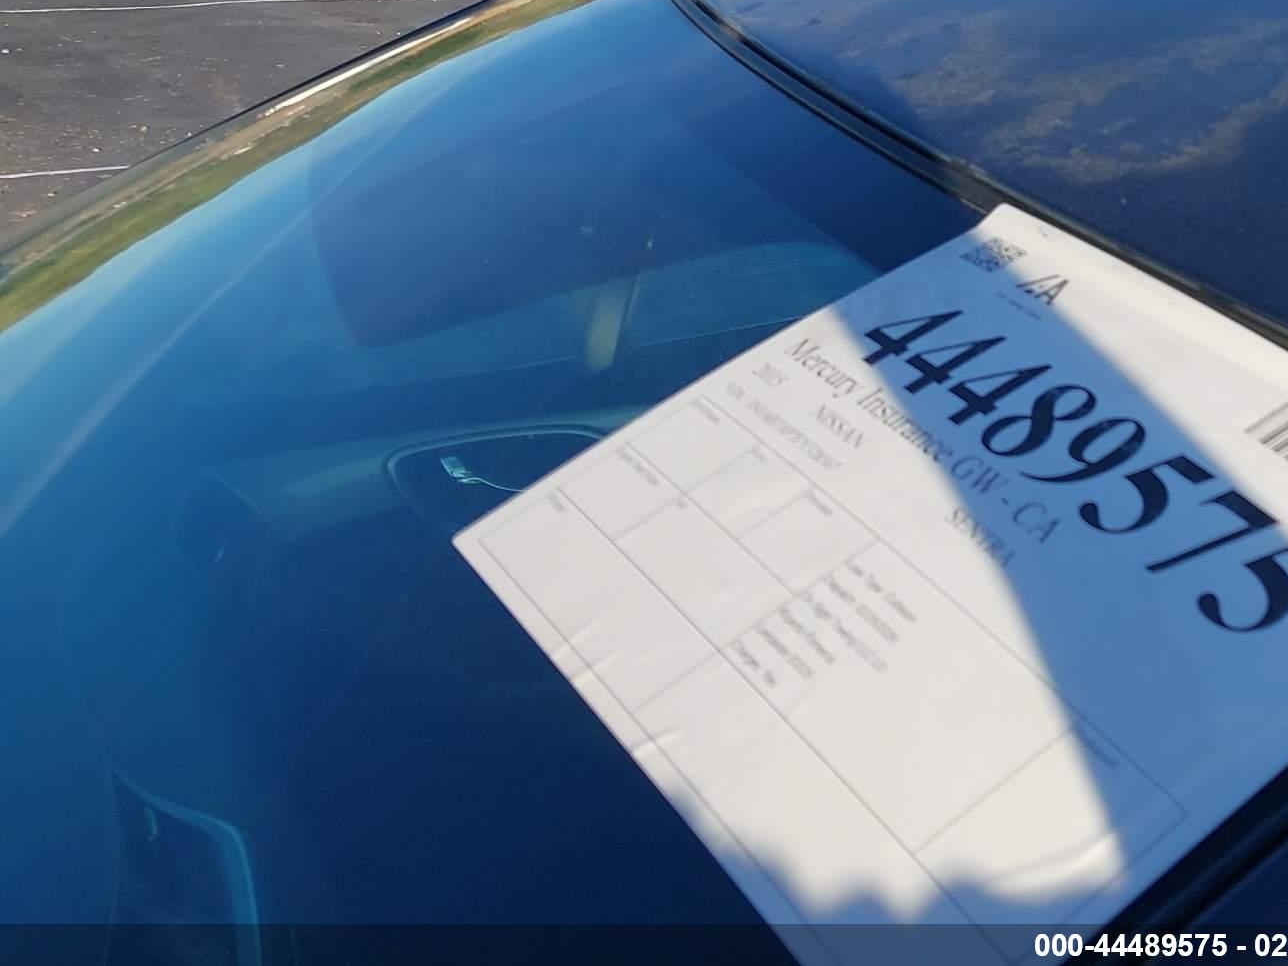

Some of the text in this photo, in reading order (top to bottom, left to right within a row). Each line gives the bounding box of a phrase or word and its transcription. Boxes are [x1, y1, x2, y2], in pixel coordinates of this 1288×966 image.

[783, 338, 859, 398] Mercury
[856, 386, 953, 462] Insurance
[951, 455, 1011, 494] GW
[1012, 500, 1062, 544] CA
[809, 403, 866, 449] NISSAN
